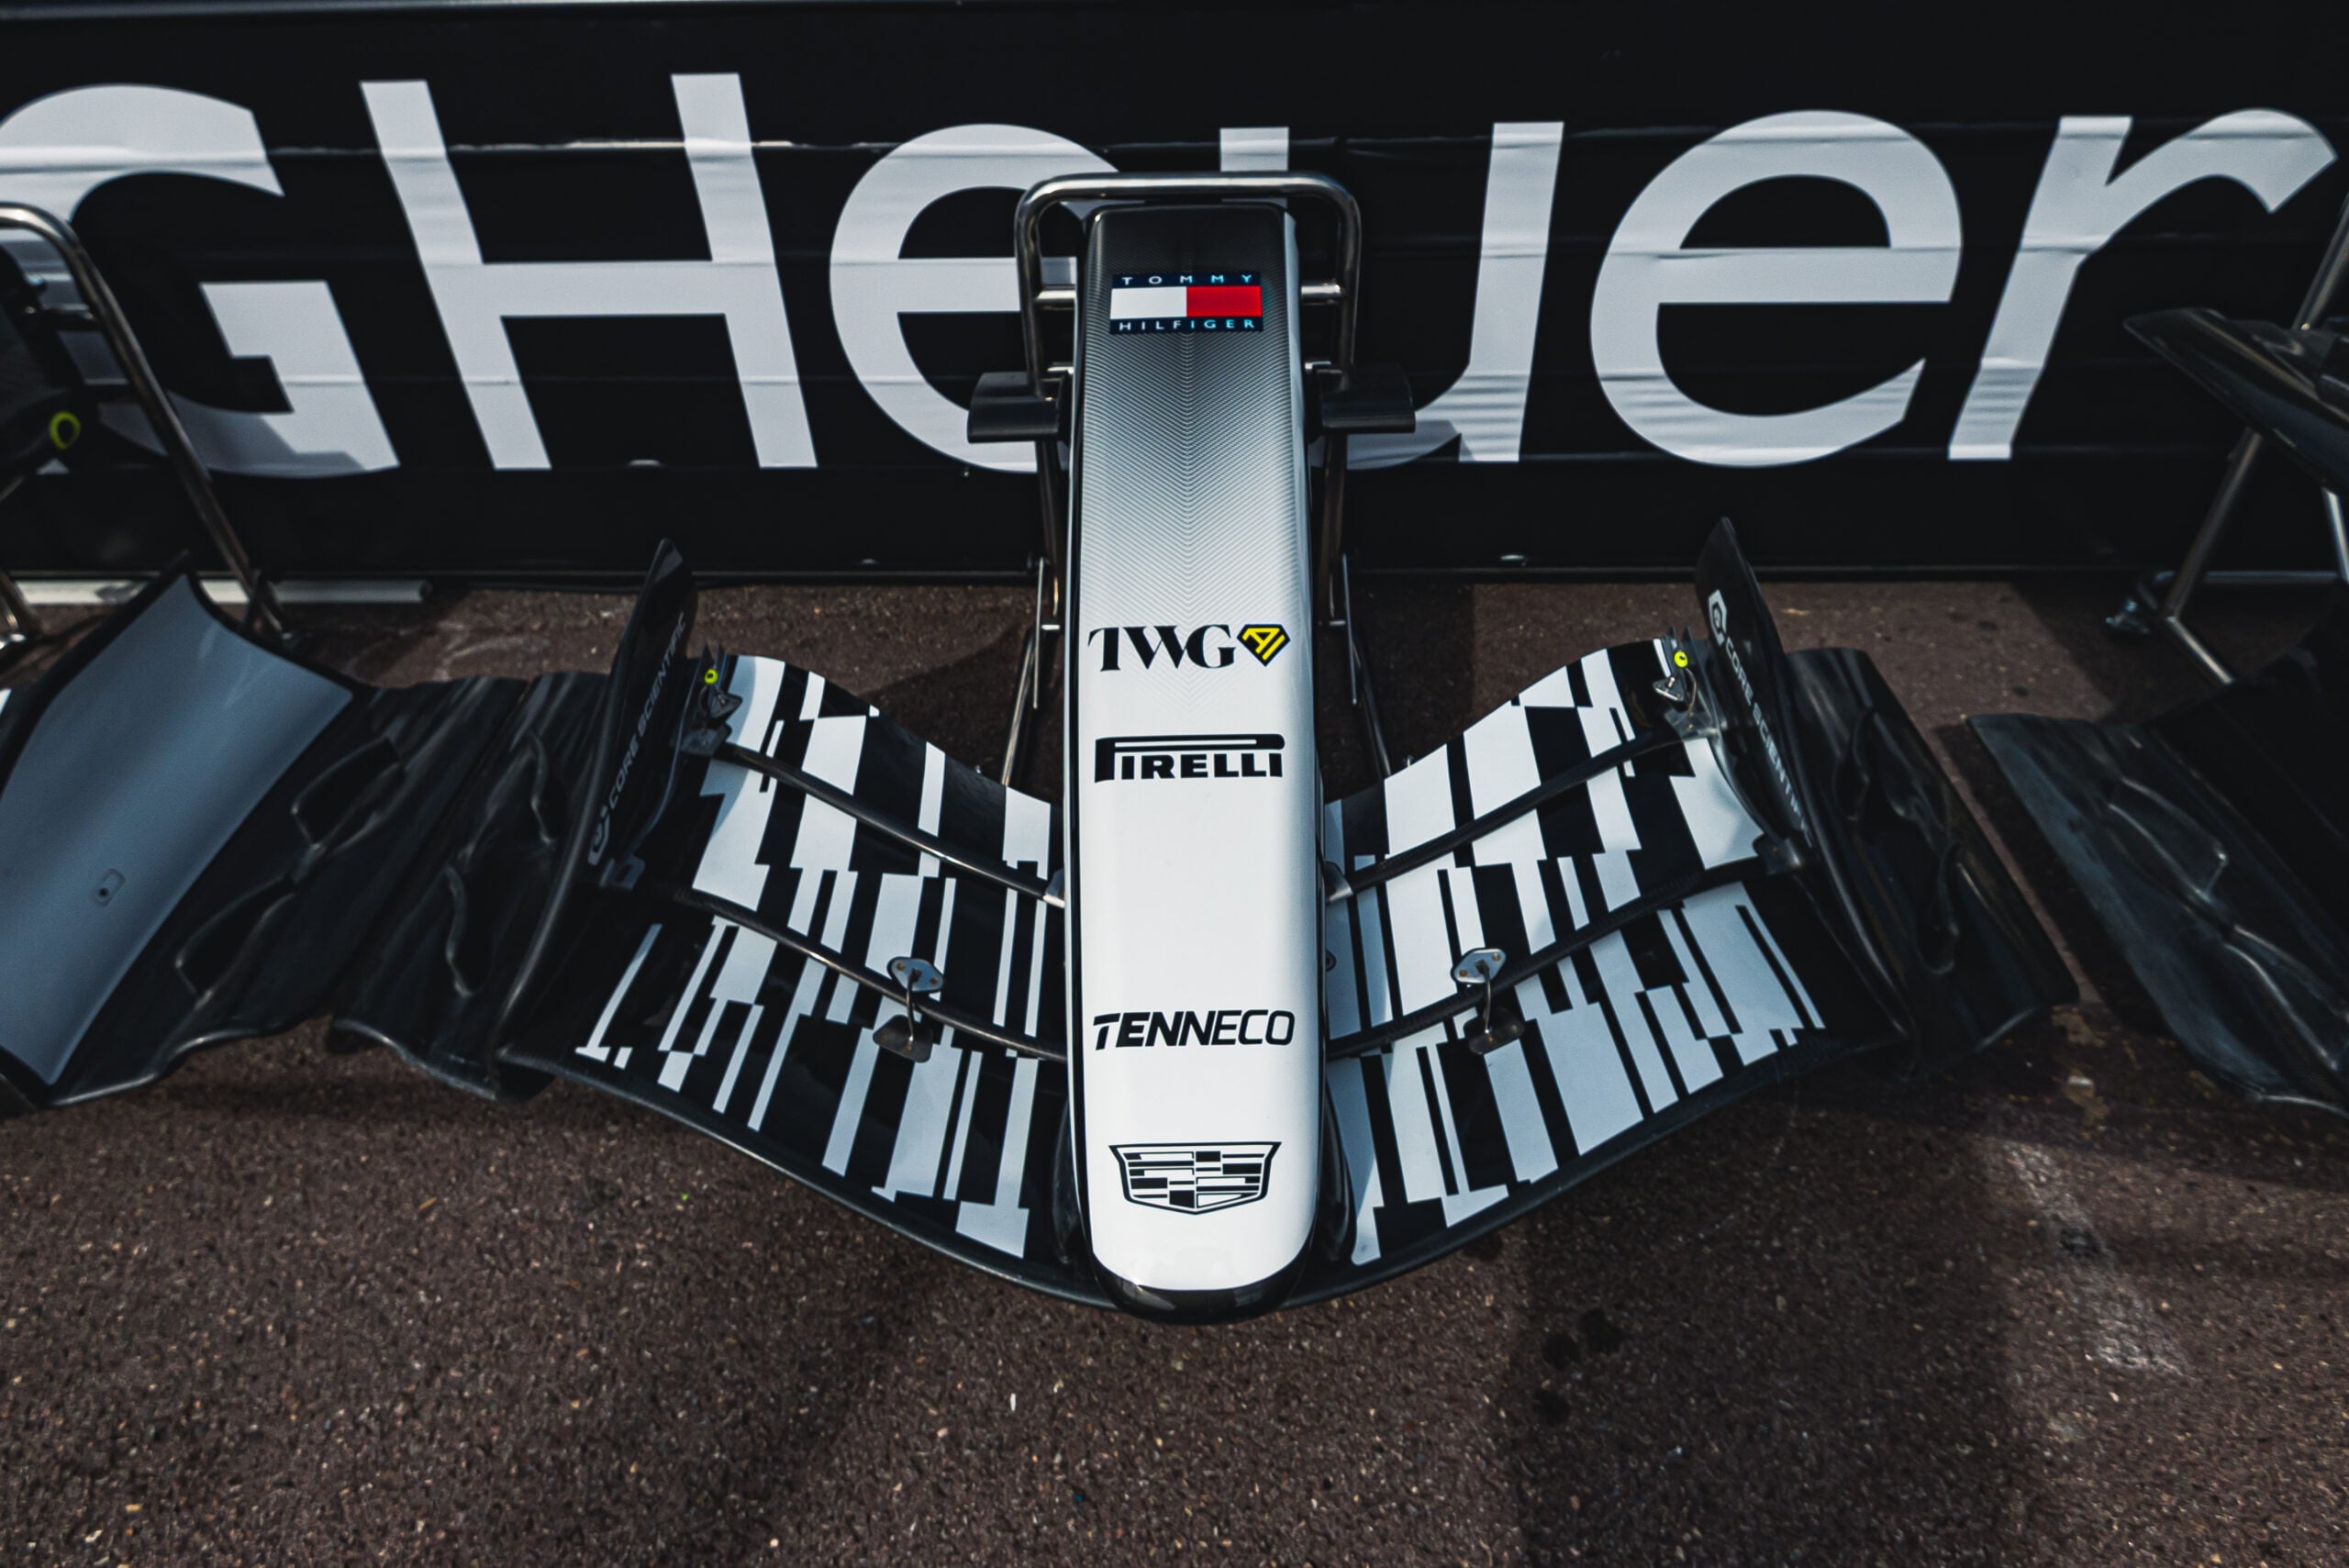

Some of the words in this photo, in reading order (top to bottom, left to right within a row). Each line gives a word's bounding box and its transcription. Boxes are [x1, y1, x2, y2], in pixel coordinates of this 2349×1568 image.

[1121, 274, 1252, 285] TOMMY
[1119, 319, 1255, 331] HILFIGER
[1088, 624, 1236, 672] TWG
[1725, 637, 1753, 706] CORE
[609, 733, 639, 809] CORE
[638, 611, 686, 737] SCIENTIFIC
[1095, 734, 1286, 783] PIRELLI
[1093, 1010, 1295, 1051] TENNECO
